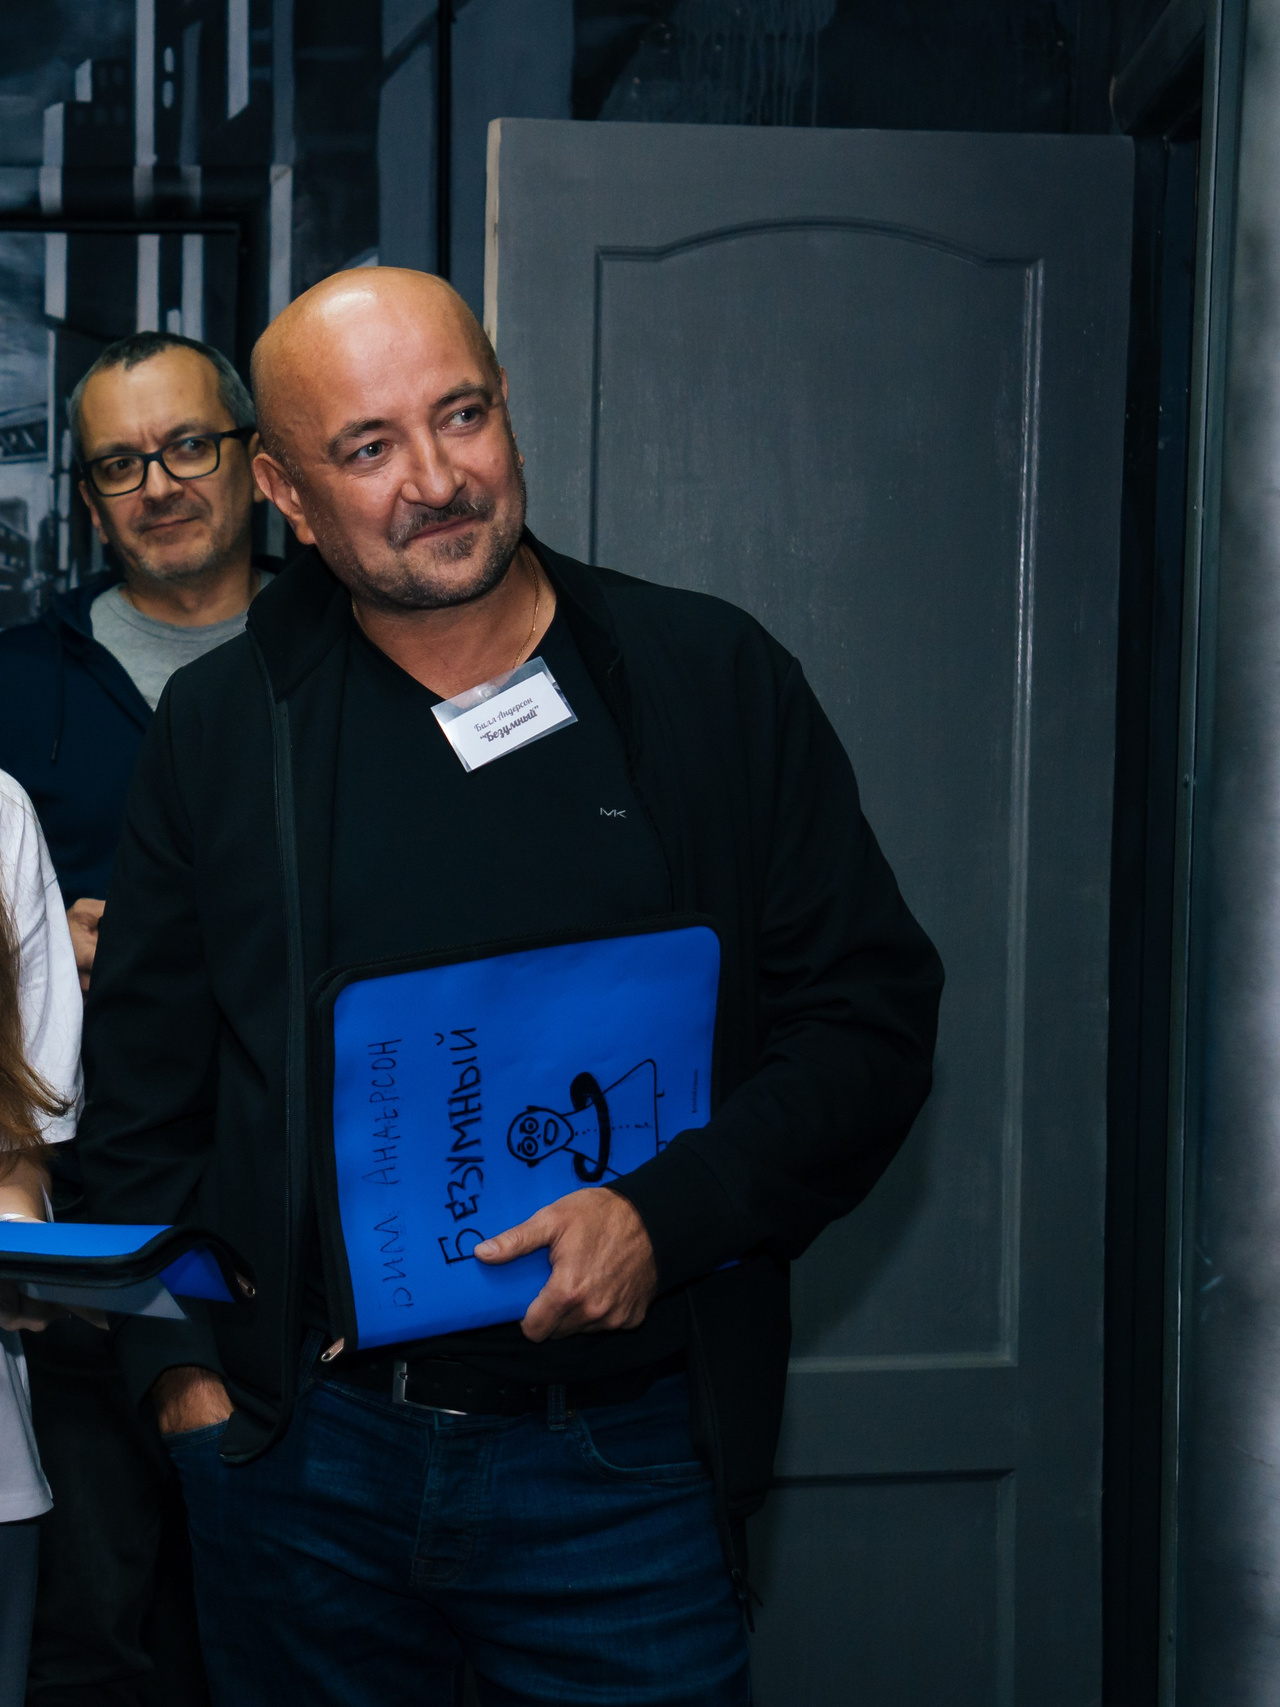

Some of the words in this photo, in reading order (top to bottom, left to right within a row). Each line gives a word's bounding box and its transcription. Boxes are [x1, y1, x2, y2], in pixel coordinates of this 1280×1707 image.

[474, 717, 497, 733] Билл
[497, 697, 534, 723] Андерсон
[434, 1026, 486, 1266] БЕЗУМНЫЙ
